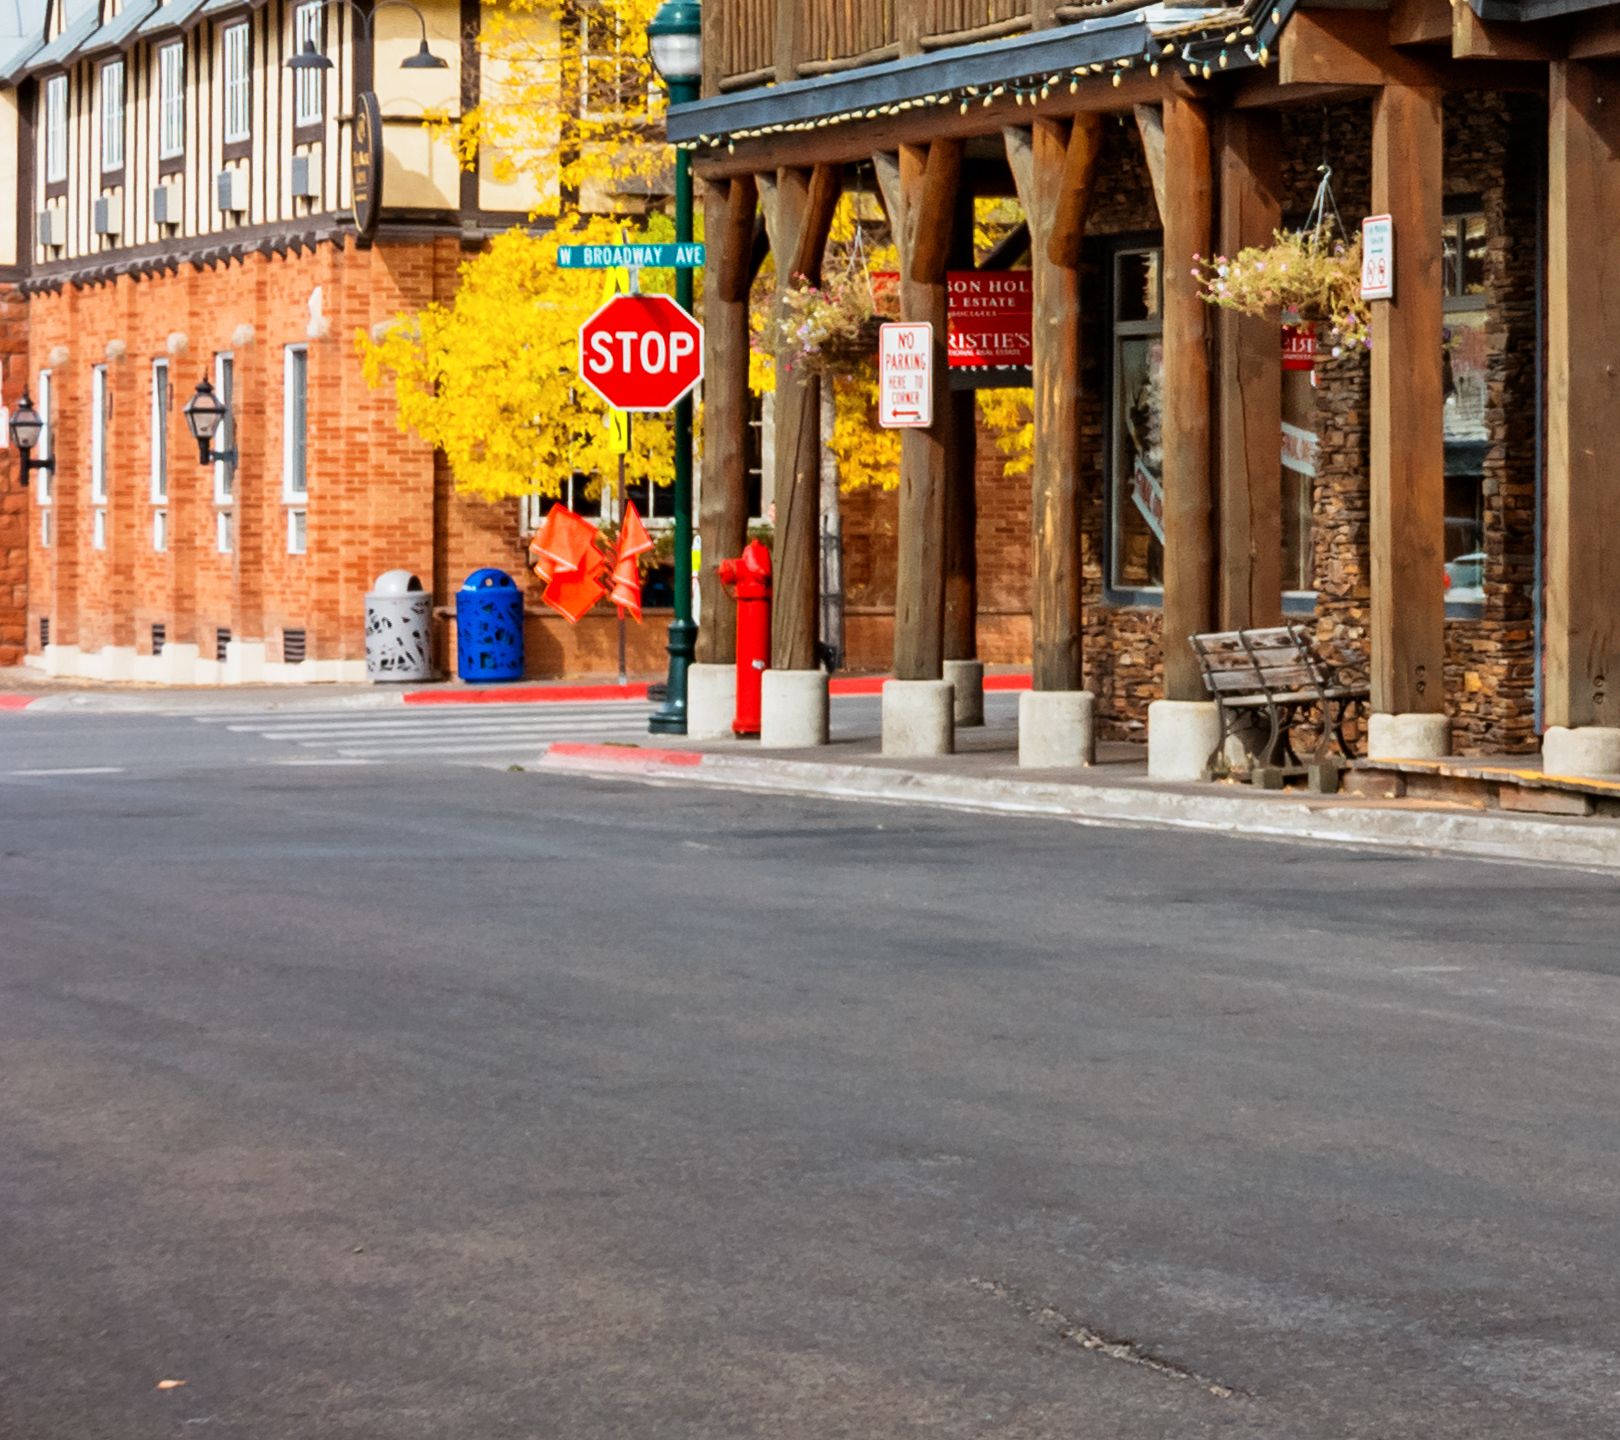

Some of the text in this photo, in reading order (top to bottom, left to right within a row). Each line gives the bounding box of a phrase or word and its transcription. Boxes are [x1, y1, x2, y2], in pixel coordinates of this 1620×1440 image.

[559, 246, 702, 266] W BROADWAY AVE
[963, 297, 1016, 307] ESTATE
[897, 331, 915, 350] NO
[588, 330, 695, 375] STOP
[885, 352, 927, 371] PARKING
[888, 375, 906, 390] HERE
[891, 391, 920, 405] CORNER
